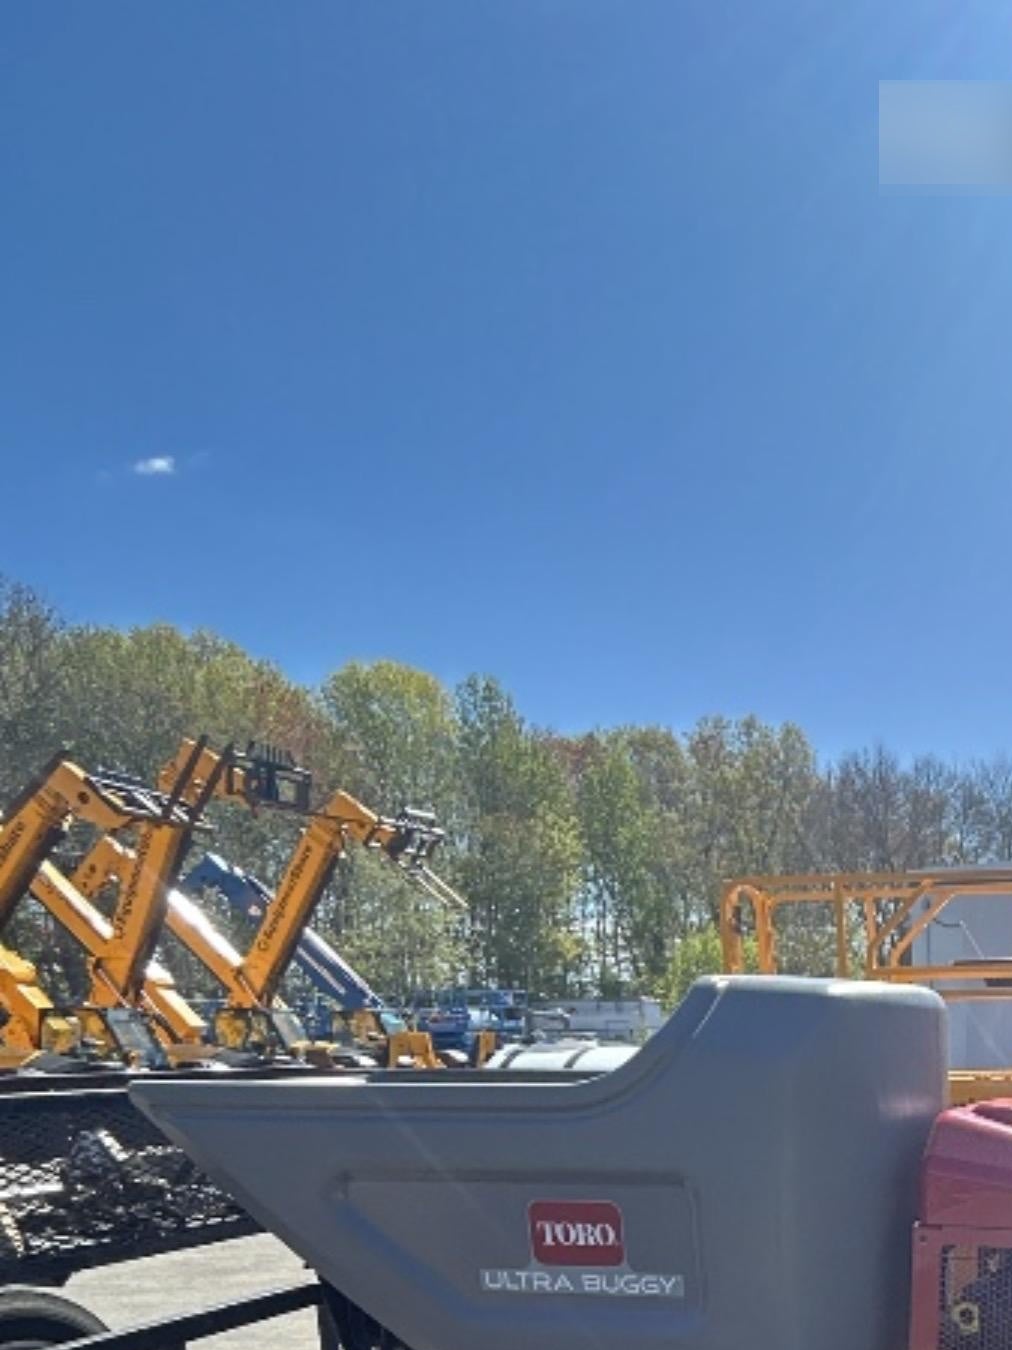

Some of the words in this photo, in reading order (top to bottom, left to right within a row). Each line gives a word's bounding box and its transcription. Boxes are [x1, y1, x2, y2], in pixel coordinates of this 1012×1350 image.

[536, 1220, 617, 1247] TORO
[484, 1271, 575, 1291] ULTRA
[581, 1273, 677, 1295] BUGGY
